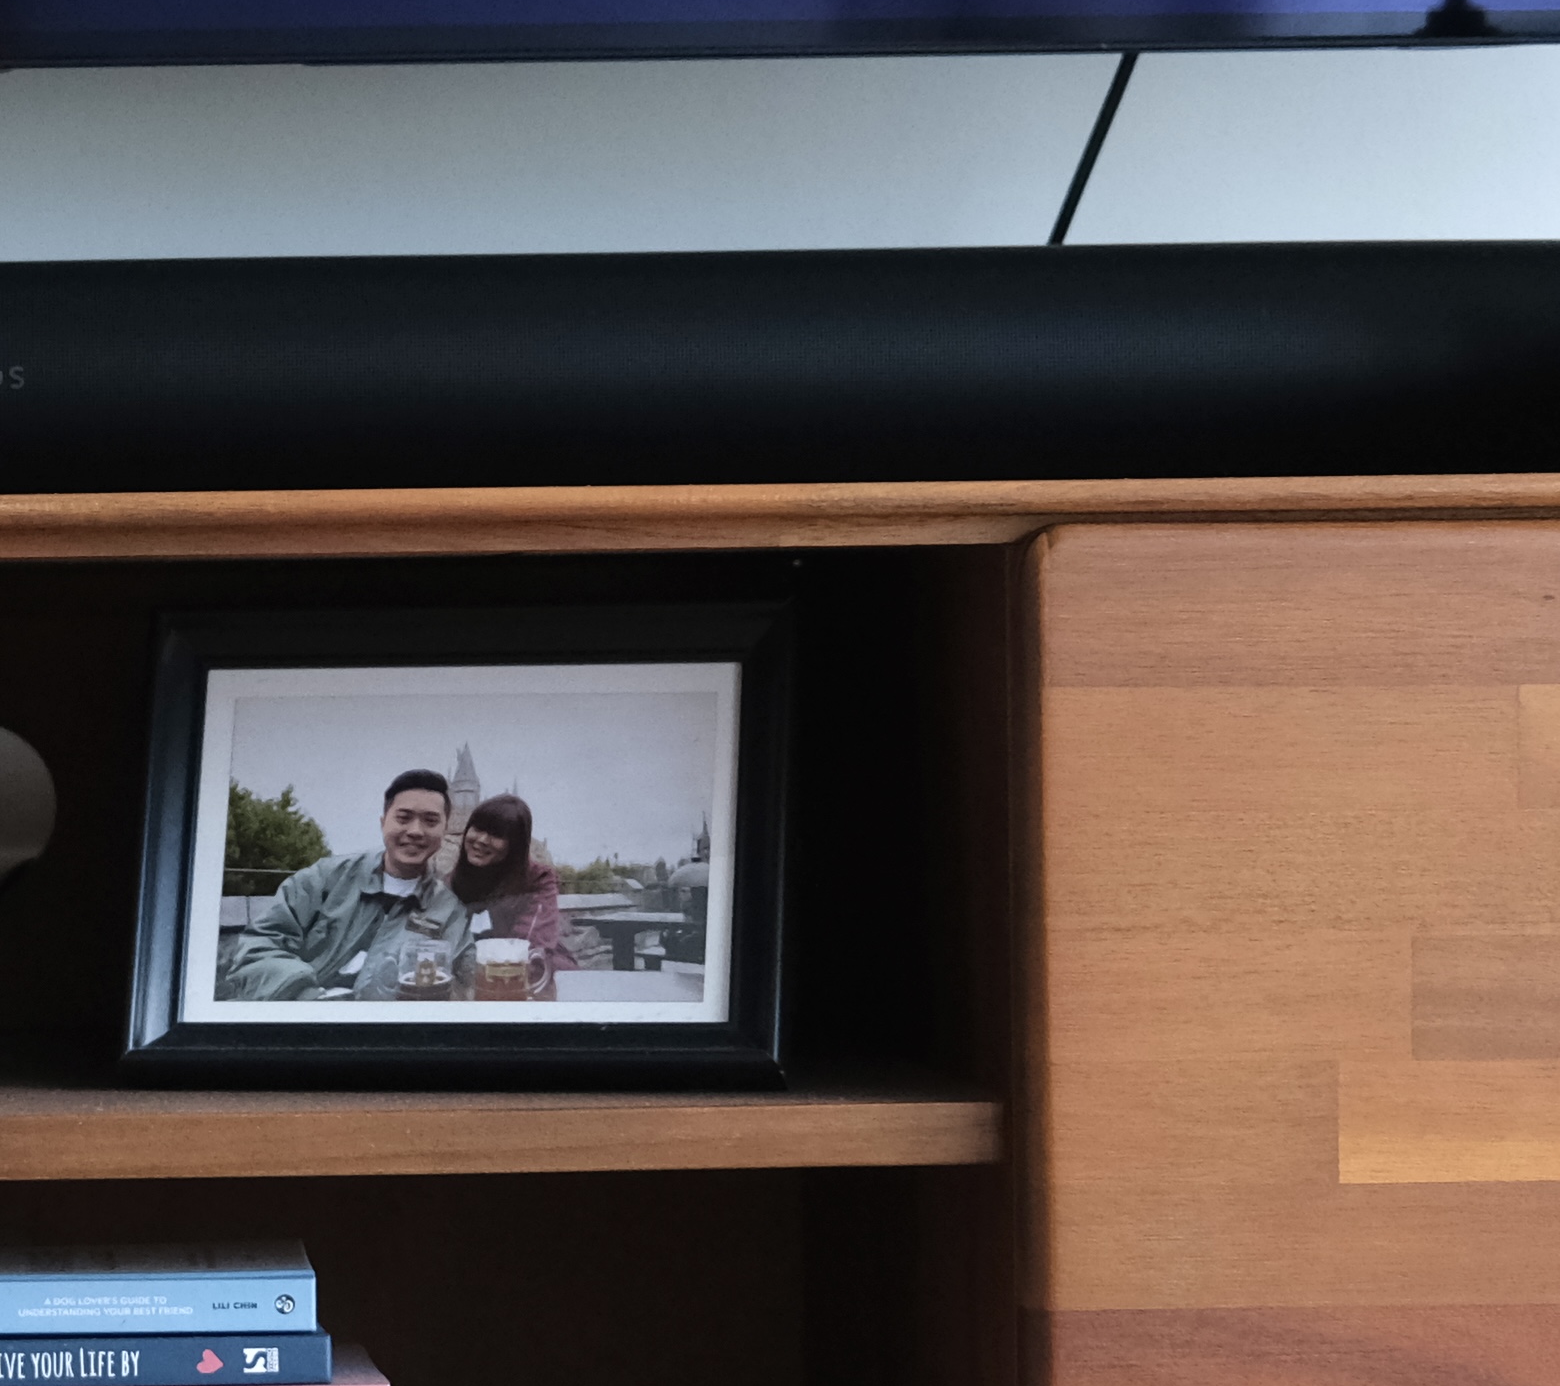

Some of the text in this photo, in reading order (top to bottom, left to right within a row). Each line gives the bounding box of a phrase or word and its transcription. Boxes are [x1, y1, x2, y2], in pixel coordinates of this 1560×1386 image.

[44, 1297, 52, 1305] A
[53, 1297, 76, 1305] DOG
[120, 1296, 150, 1305] GUIDE
[153, 1295, 167, 1304] TO
[212, 1302, 230, 1310] LILI
[18, 1306, 193, 1317] UNDERSTANDING YOUR BEST FRIEND
